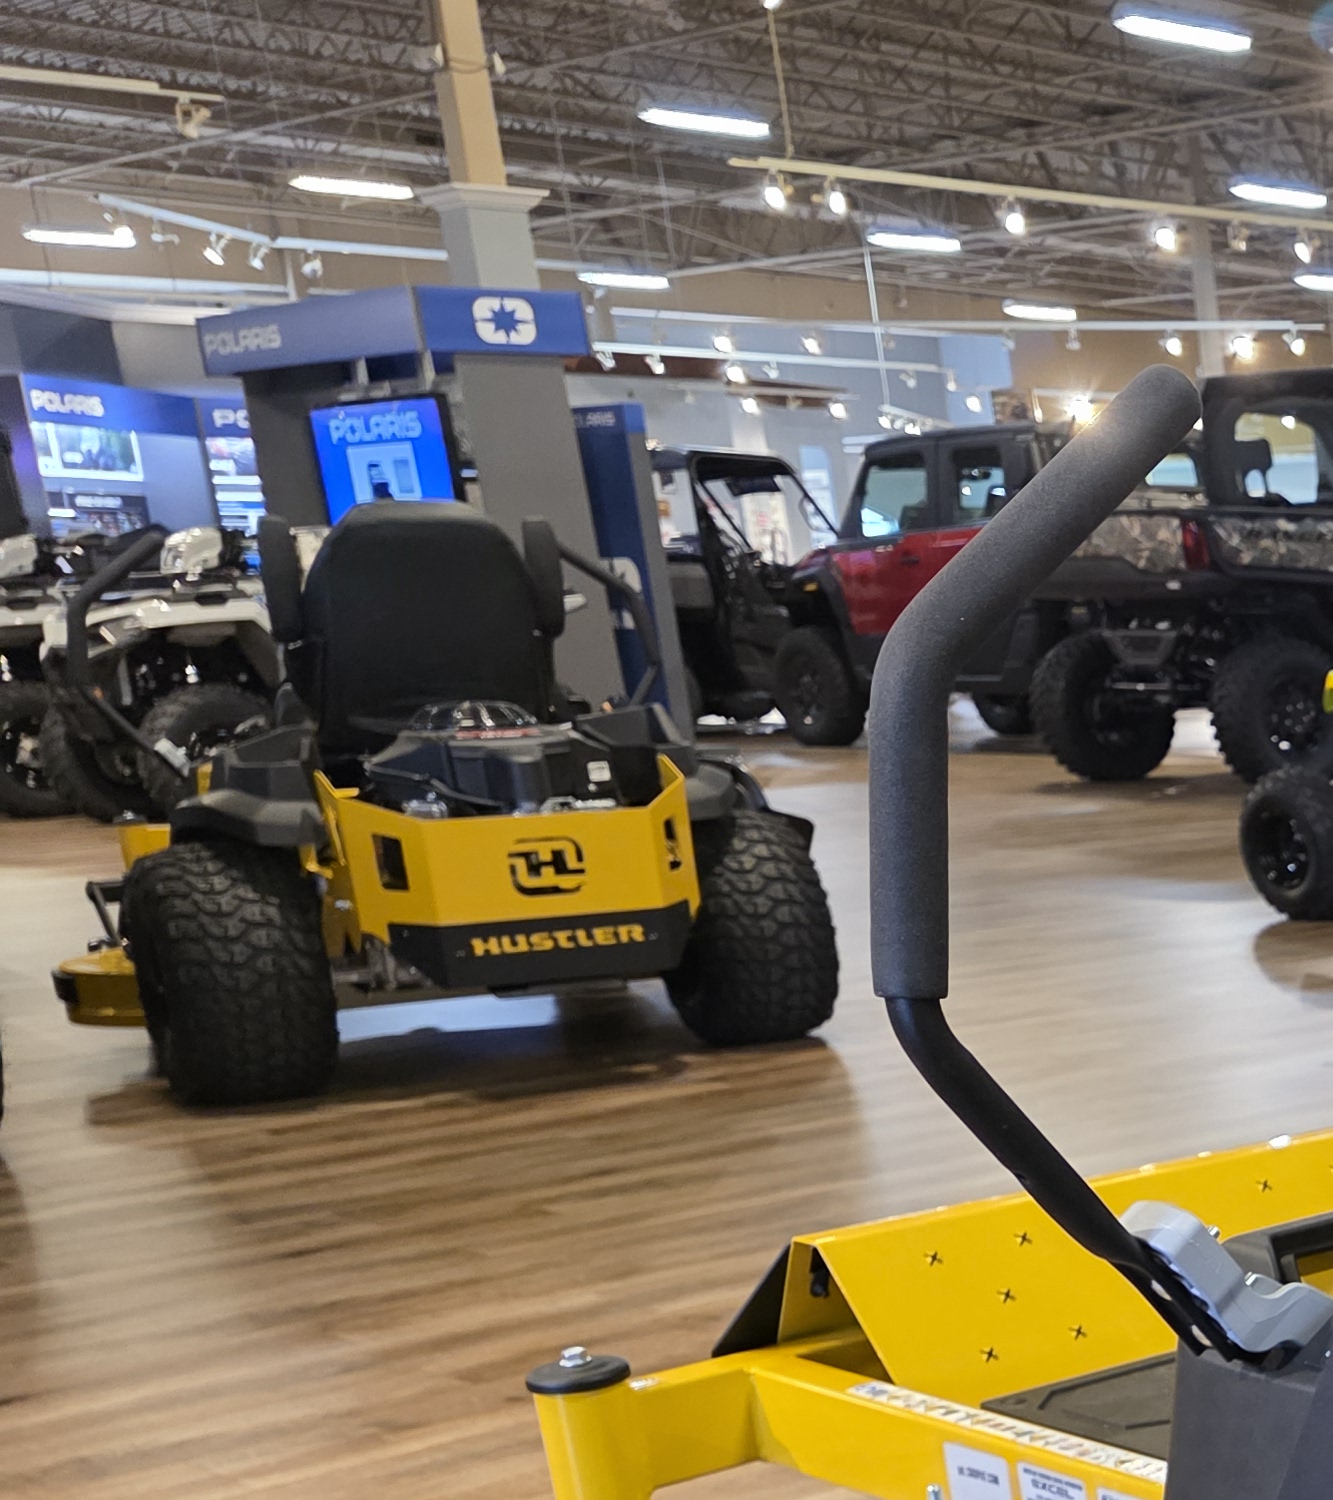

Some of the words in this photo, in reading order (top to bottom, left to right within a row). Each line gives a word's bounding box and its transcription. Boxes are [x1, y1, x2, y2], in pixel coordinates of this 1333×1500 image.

[205, 323, 283, 355] POLARIS
[329, 410, 424, 446] POLARIS
[469, 924, 646, 957] HUSTLER
